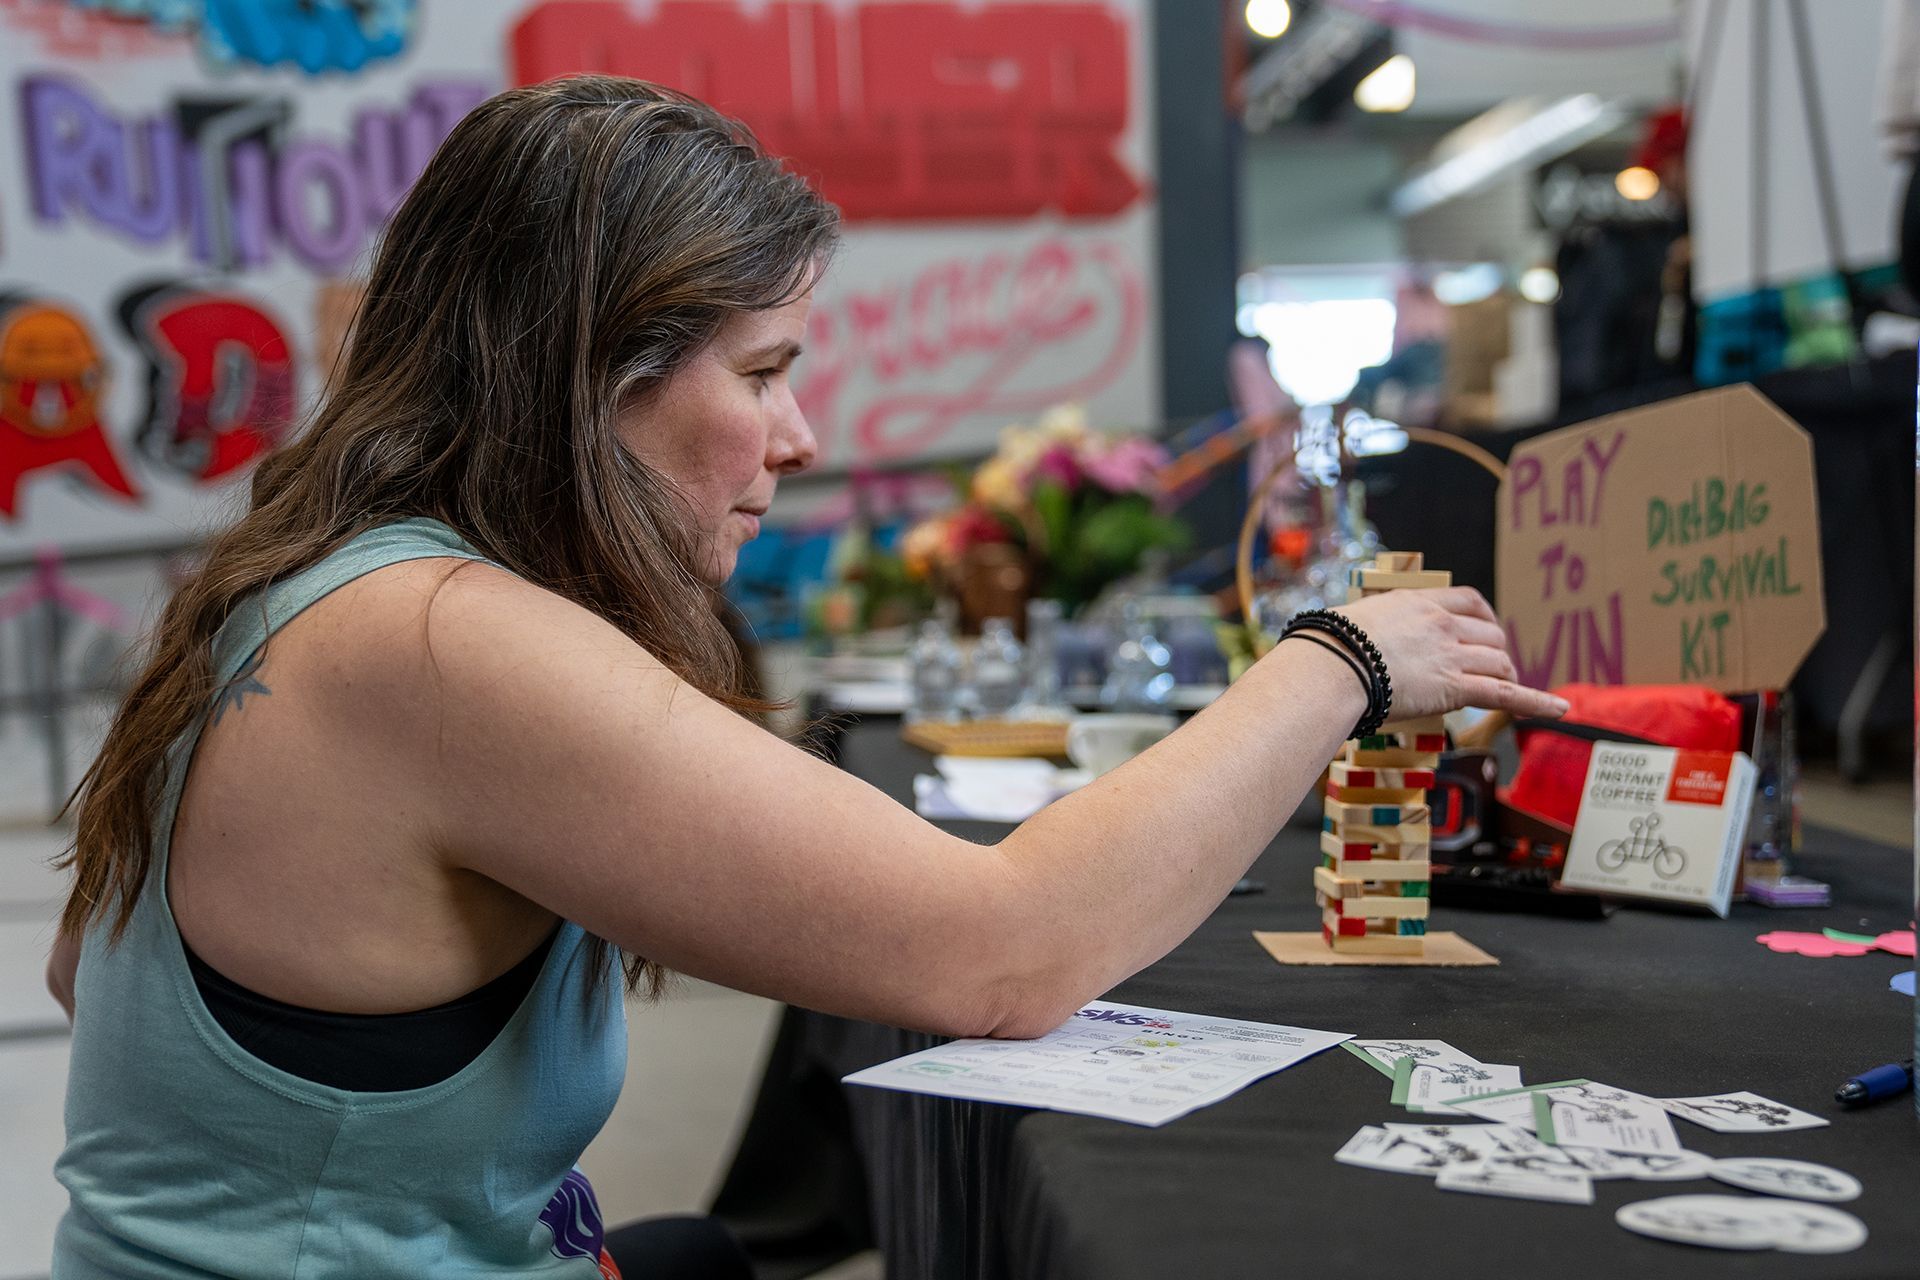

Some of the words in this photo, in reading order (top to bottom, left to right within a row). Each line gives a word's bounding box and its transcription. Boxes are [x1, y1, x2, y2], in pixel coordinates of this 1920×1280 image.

[1511, 429, 1627, 531] PLAY
[1538, 541, 1586, 601] TO
[1651, 536, 1803, 606] SURVIVAL
[1506, 591, 1625, 688] WIN
[1680, 610, 1730, 681] KIT
[1594, 769, 1666, 786] INSTANT
[1598, 751, 1647, 767] GOOD
[1590, 783, 1657, 801] COFFEE
[1141, 1029, 1204, 1041] BINGO
